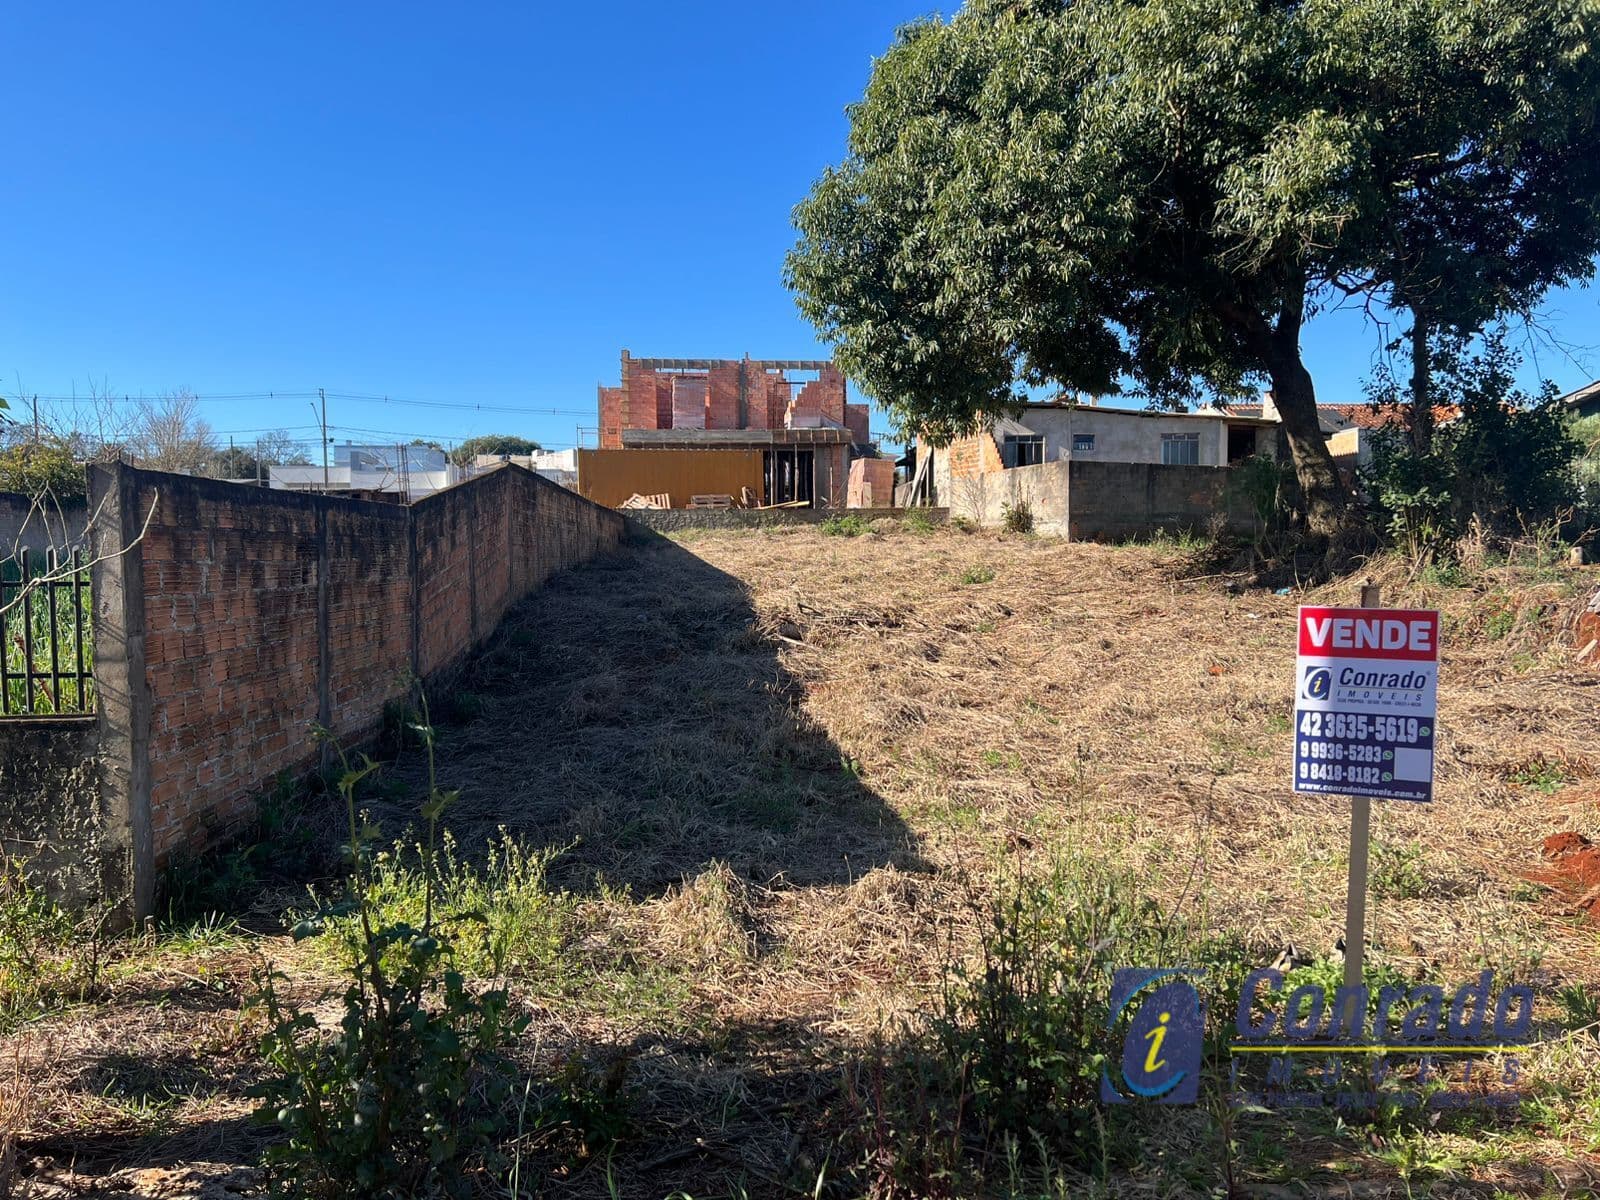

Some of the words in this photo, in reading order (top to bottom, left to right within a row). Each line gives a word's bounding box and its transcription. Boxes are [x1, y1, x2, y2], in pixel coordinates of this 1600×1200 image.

[1306, 617, 1431, 651] VENDE
[1339, 667, 1426, 690] Conrado
[1300, 712, 1321, 737] 42
[1325, 713, 1419, 743] 3635-5619
[1300, 741, 1309, 758] 9
[1311, 741, 1381, 763] 9936-5283
[1300, 762, 1309, 779] 9
[1311, 763, 1380, 784] 8418-8182
[1298, 782, 1426, 799] www.conradoimoveis.com.br
